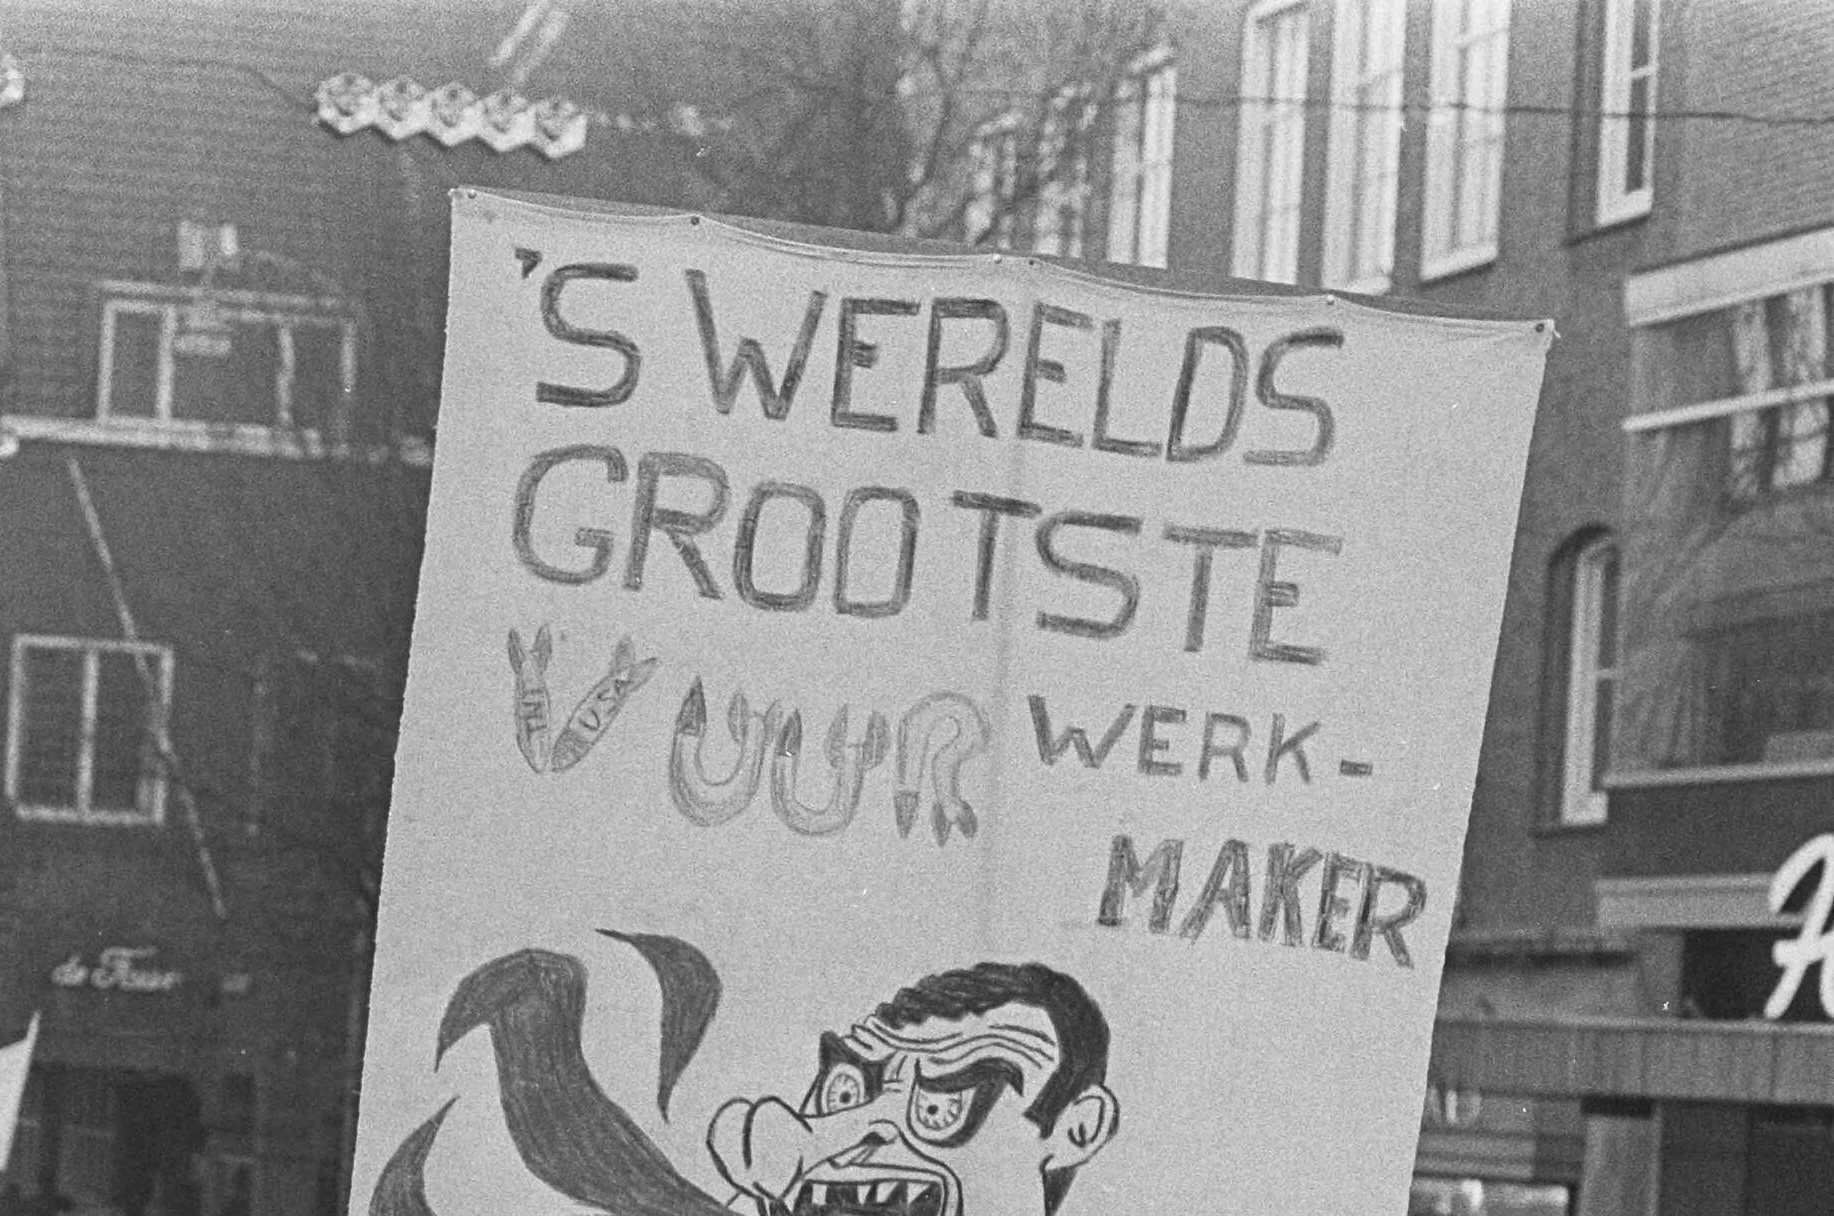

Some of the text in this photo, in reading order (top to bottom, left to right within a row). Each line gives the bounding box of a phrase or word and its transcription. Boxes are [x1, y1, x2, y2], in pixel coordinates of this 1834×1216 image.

[684, 268, 1346, 466] WERELDS
[511, 443, 1344, 666] GROOTSTE
[1026, 692, 1374, 786] WERK-
[1096, 832, 1430, 970] MAKER
